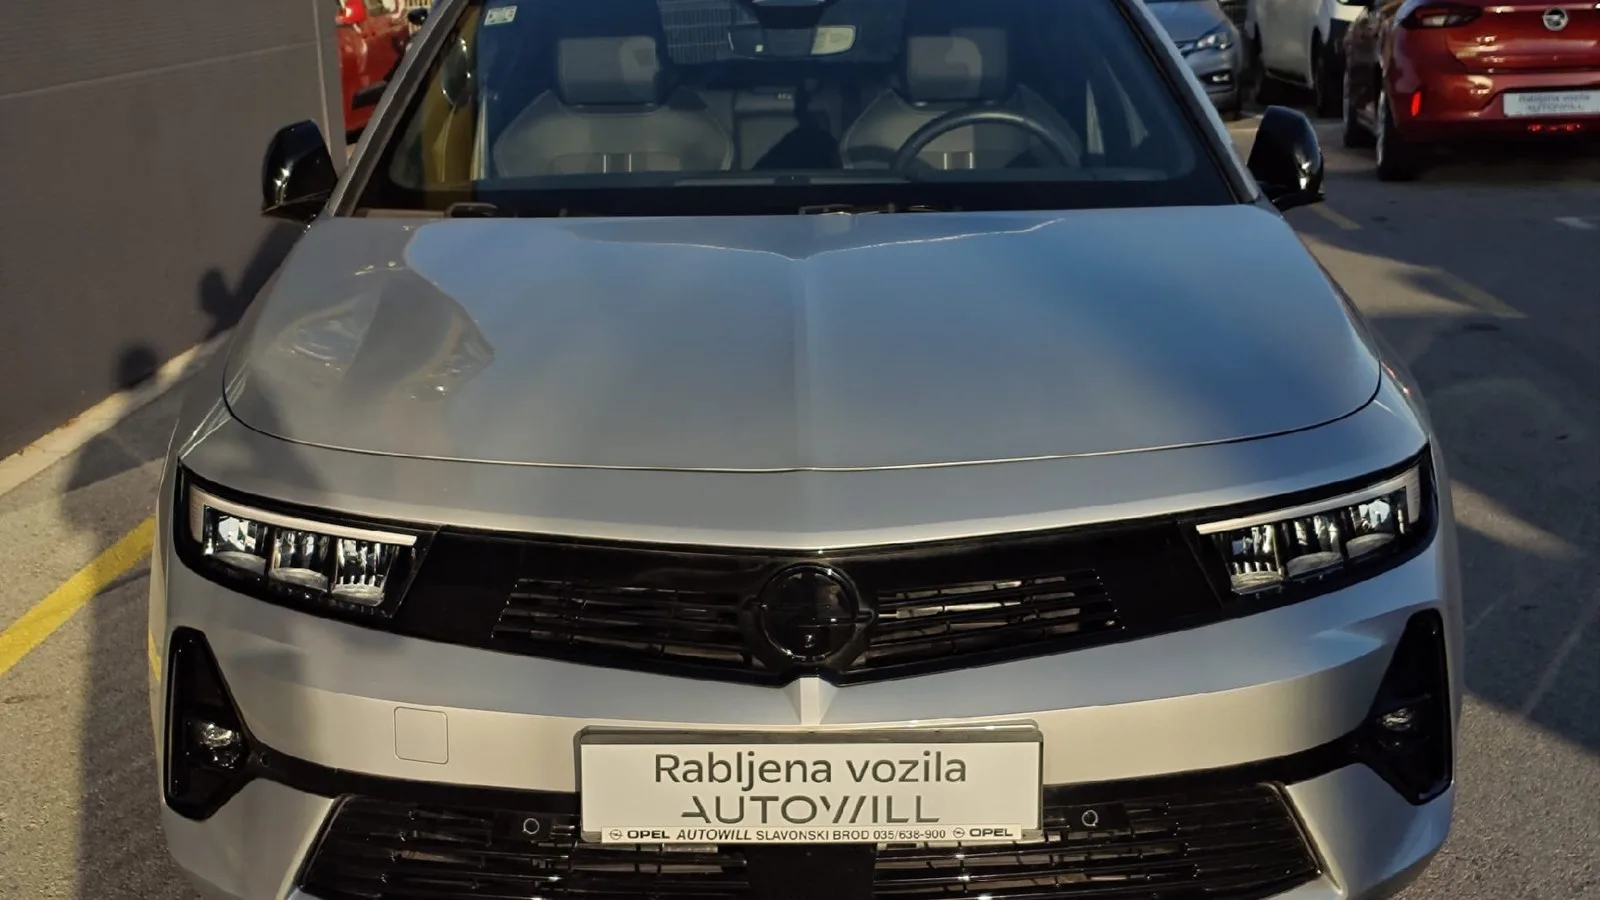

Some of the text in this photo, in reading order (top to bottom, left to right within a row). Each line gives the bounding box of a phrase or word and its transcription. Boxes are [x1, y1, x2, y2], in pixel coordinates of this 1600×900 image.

[654, 750, 967, 792] Rabljena vozila
[681, 795, 940, 824] AUTOWILL
[627, 828, 1014, 841] OPEL AUTOWILL SLAVONSKI BROD 035/638-900 OPEL
